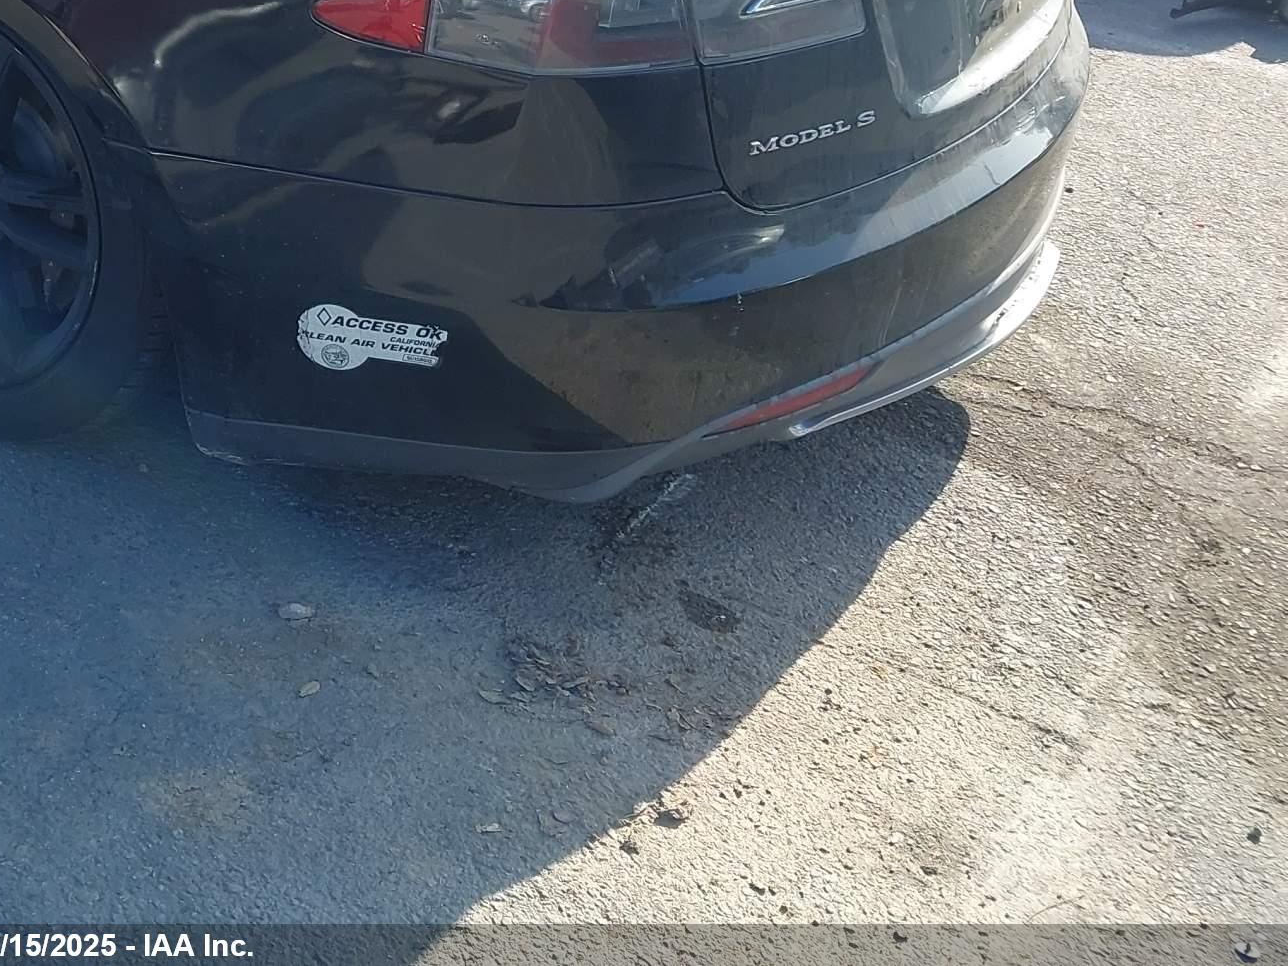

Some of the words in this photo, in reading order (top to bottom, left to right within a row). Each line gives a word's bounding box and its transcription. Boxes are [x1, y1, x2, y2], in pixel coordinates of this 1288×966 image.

[749, 120, 852, 156] MODEL
[856, 110, 876, 128] S
[332, 316, 408, 335] ACCESS
[415, 325, 442, 341] OK
[350, 338, 376, 349] AIR
